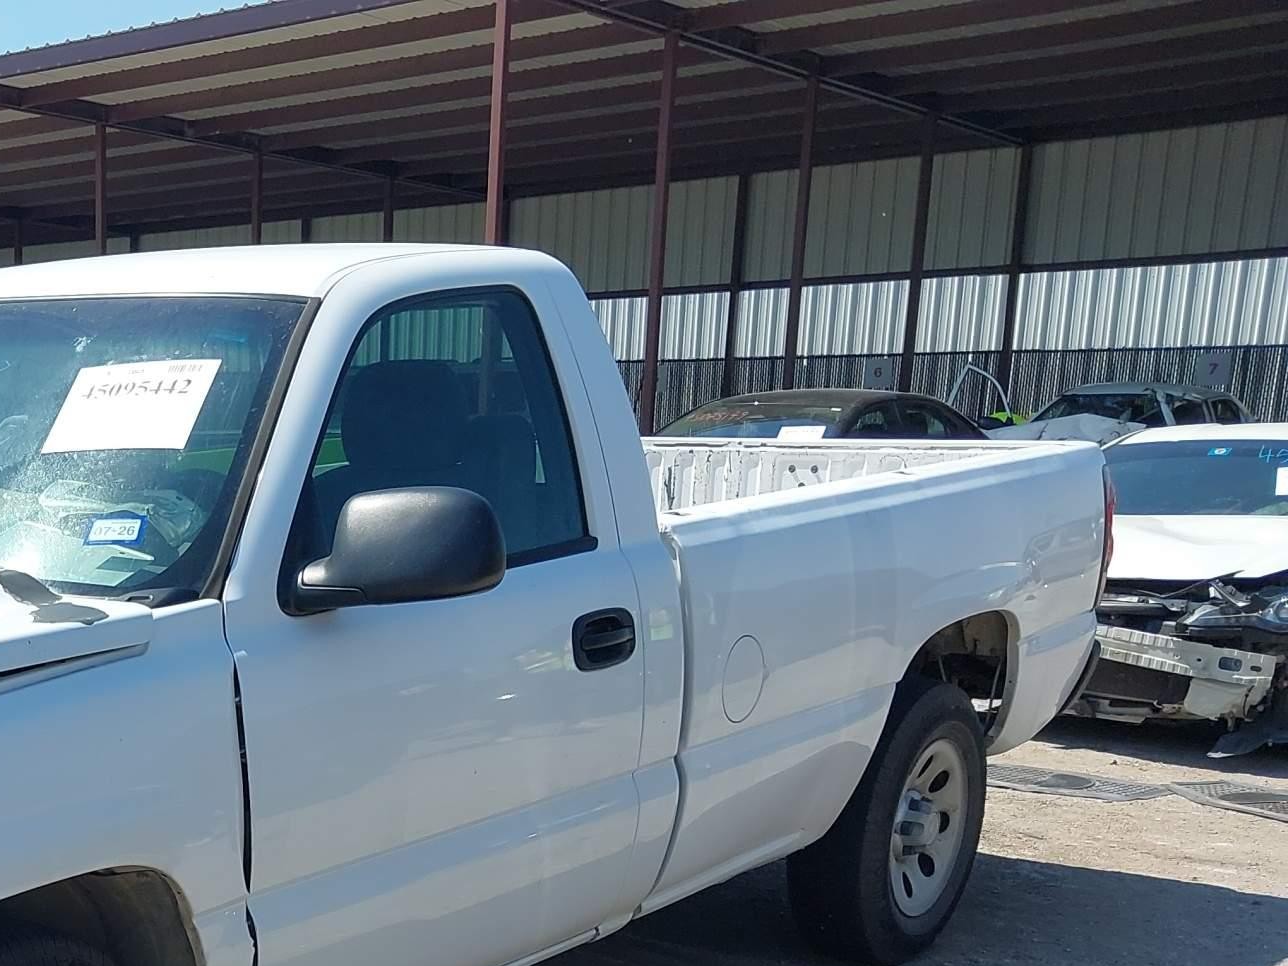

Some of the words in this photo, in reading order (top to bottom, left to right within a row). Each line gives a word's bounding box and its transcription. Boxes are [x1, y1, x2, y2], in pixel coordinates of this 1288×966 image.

[873, 367, 882, 378] 6
[1208, 362, 1219, 375] 7
[82, 378, 193, 400] 45095442
[93, 525, 136, 537] 07-26
